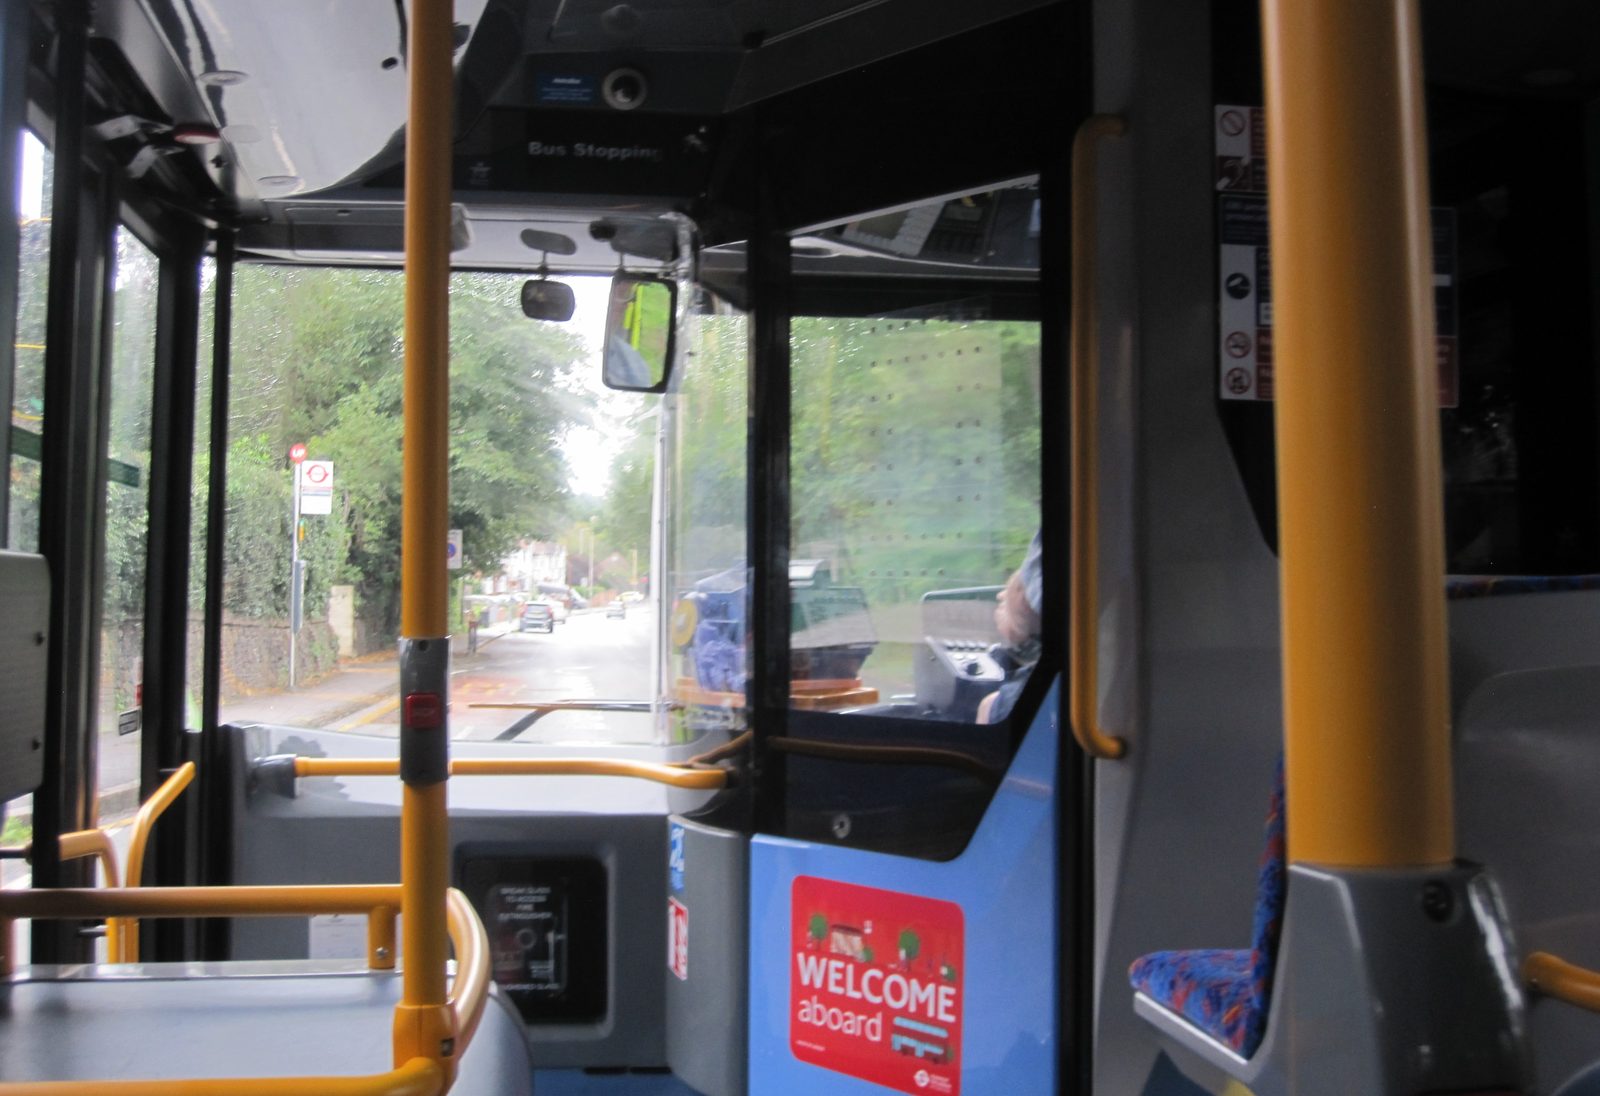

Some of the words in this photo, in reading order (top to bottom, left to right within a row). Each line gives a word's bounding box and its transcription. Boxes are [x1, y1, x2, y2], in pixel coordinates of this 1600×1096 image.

[528, 141, 568, 157] Bus
[797, 952, 956, 1023] WELCOME
[798, 996, 882, 1043] aboard
